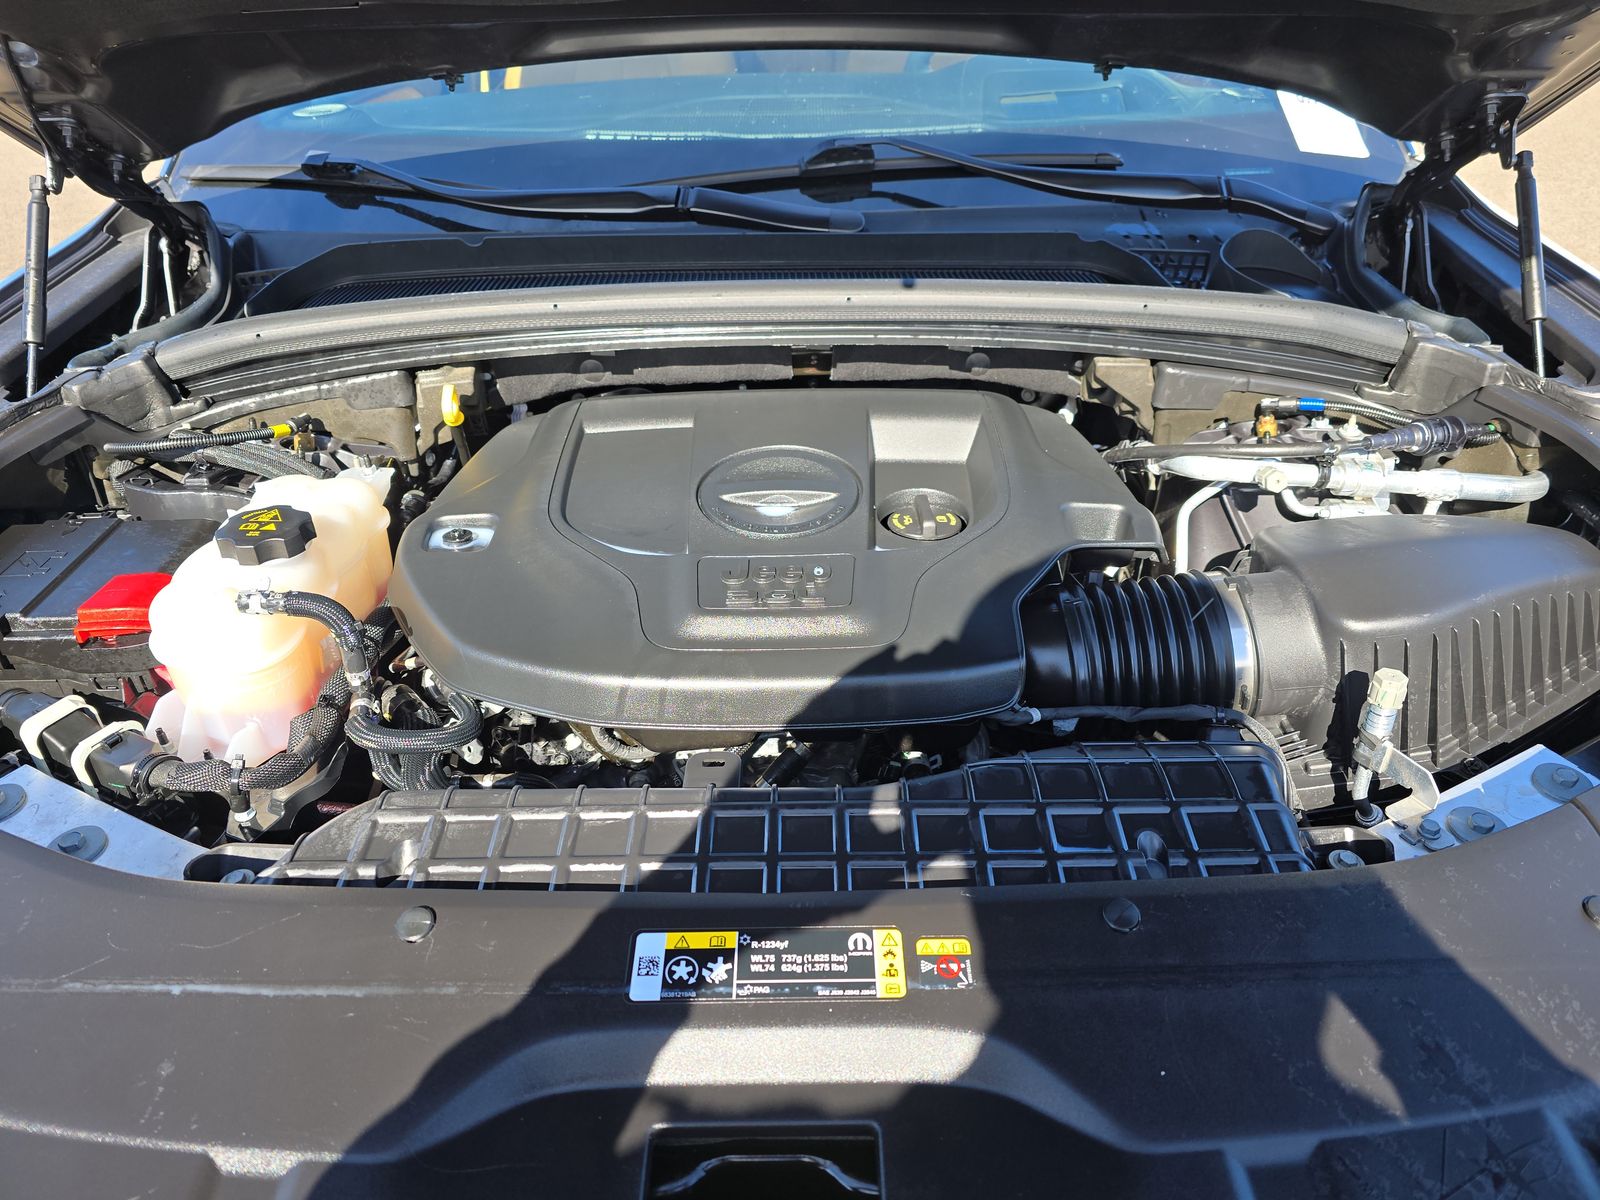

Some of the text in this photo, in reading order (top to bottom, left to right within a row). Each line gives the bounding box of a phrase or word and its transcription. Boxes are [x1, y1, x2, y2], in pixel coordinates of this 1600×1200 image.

[720, 559, 832, 588] Jeep
[751, 940, 789, 950] R-1234yf
[751, 953, 848, 965] WL75 737g (1.625 lbs)
[751, 963, 848, 974] WL74 624g (1.375 lbs)
